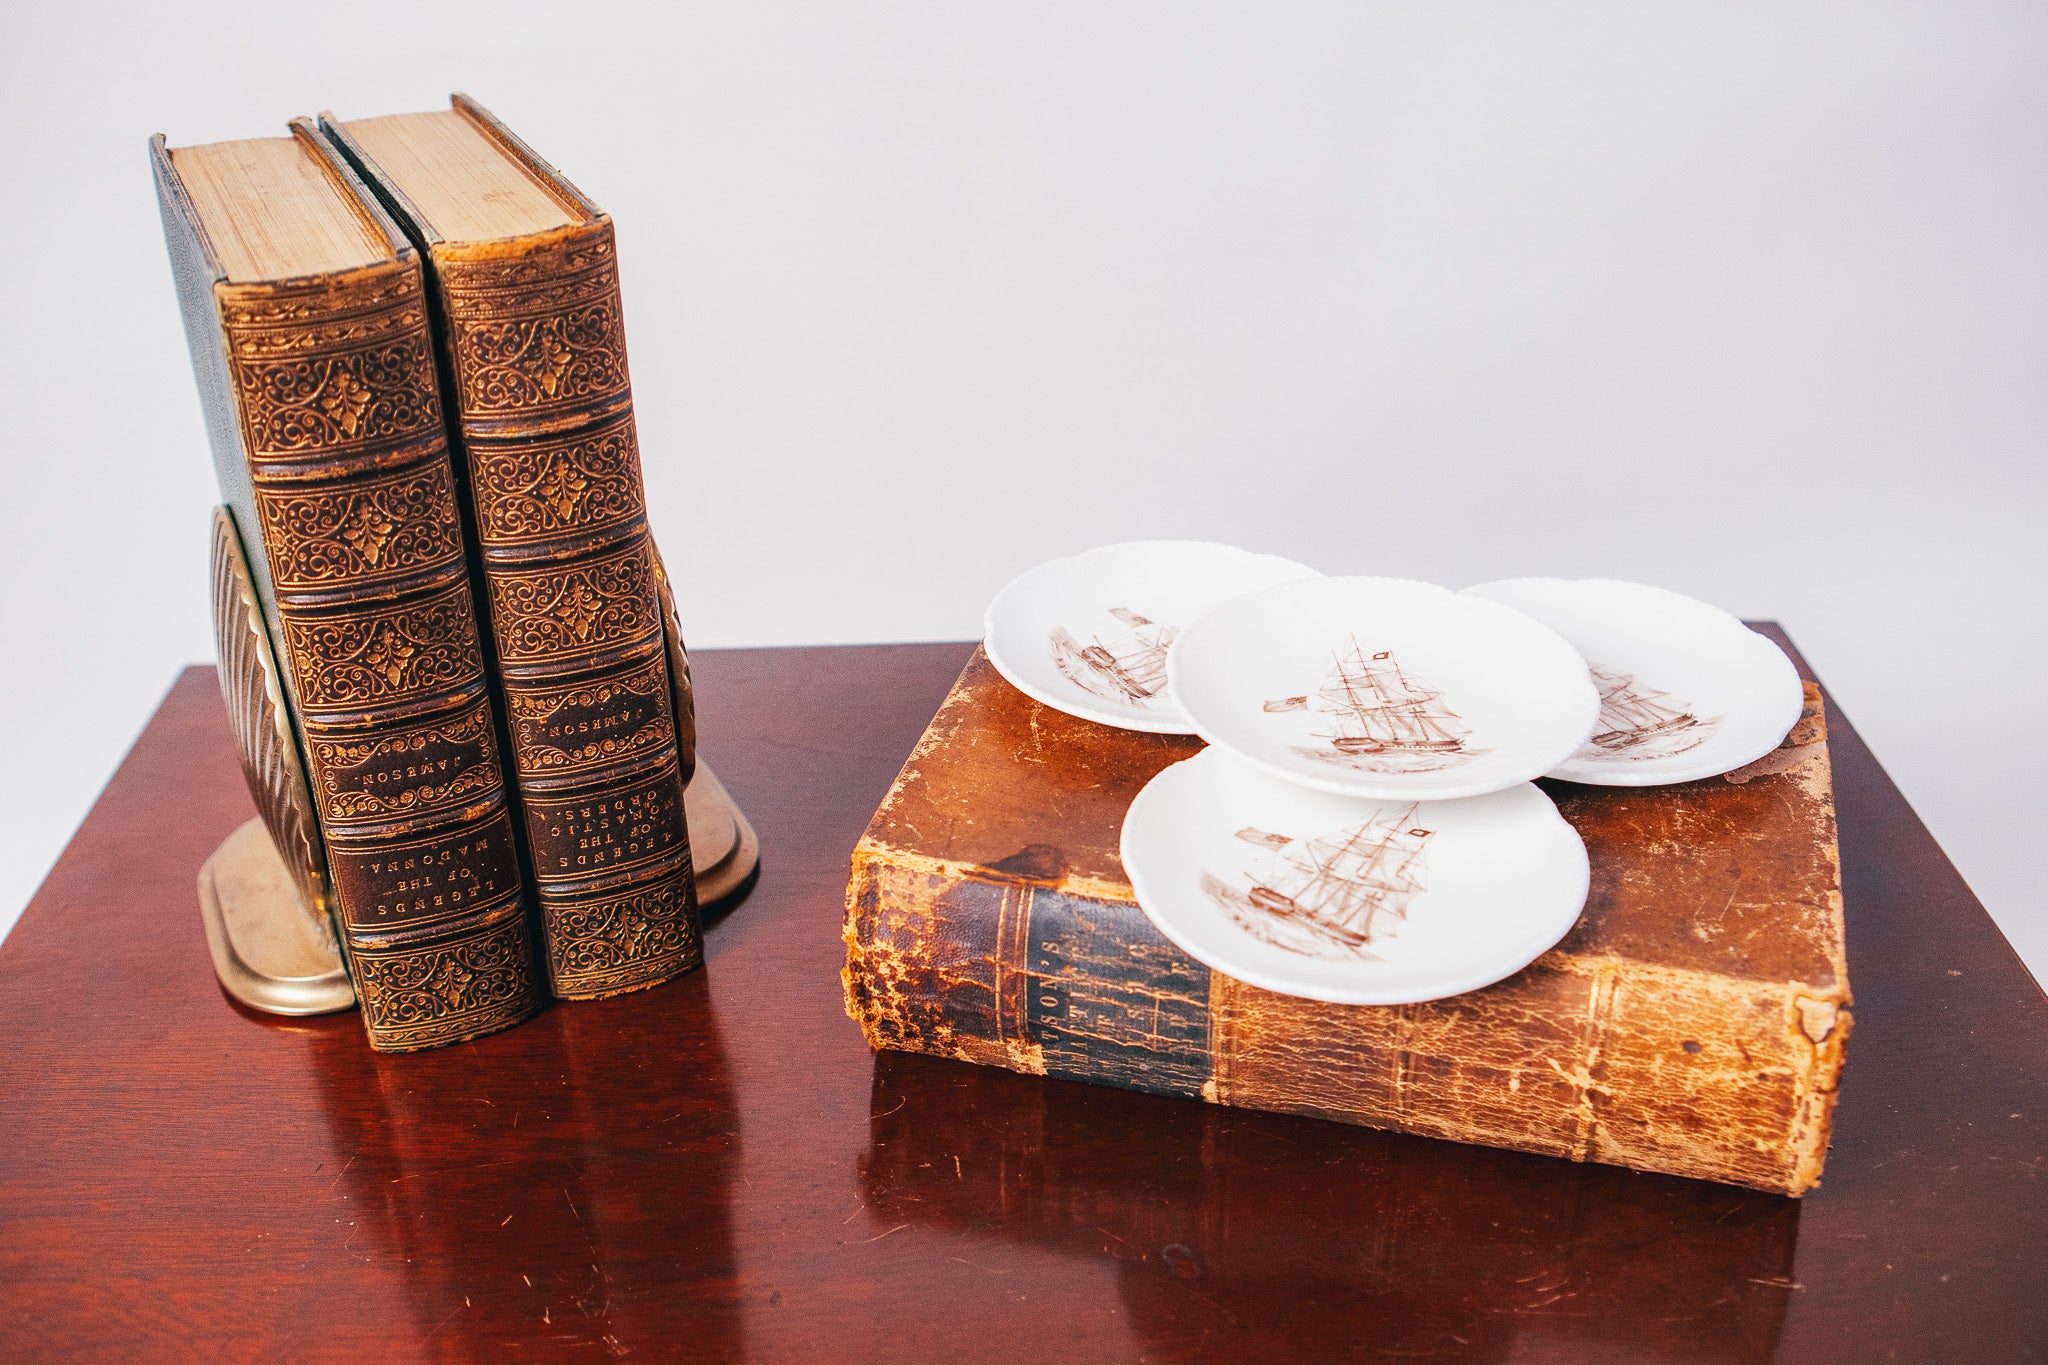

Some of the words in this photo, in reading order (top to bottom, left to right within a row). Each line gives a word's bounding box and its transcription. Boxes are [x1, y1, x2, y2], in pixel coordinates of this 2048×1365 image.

[541, 708, 642, 737] JAMESON.
[354, 755, 461, 786] JAMESON.
[551, 797, 675, 837] MONASTIC
[556, 790, 657, 820] ORDERS.
[579, 833, 613, 848] THE
[630, 823, 651, 839] OF
[361, 838, 488, 872] MADONNA.
[560, 831, 671, 868] LEGENDS
[397, 876, 432, 891] THE
[447, 867, 472, 882] OF
[377, 879, 494, 916] LEGENDS
